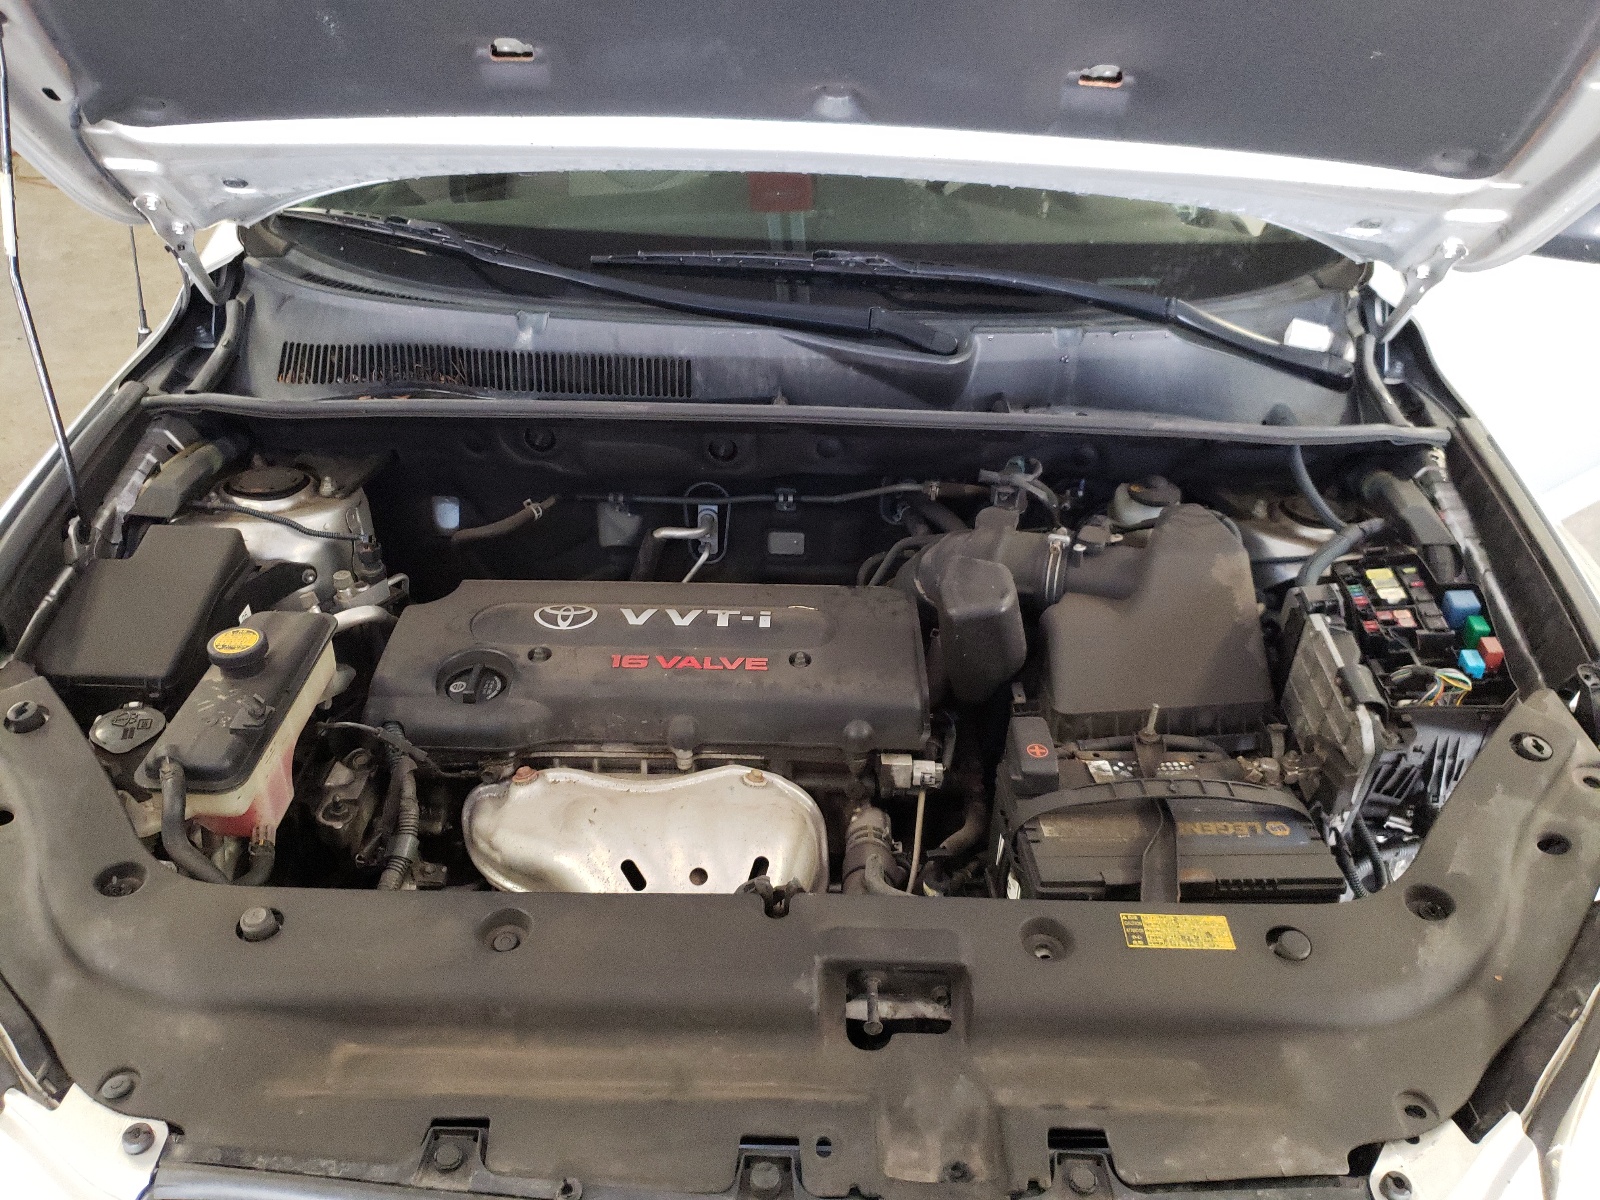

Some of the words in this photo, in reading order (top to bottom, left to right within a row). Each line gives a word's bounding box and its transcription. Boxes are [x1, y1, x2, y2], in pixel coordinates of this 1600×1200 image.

[620, 608, 771, 628] VVT-i
[611, 654, 650, 668] 16
[656, 655, 769, 671] VALVE
[1177, 821, 1263, 836] LEGEN
